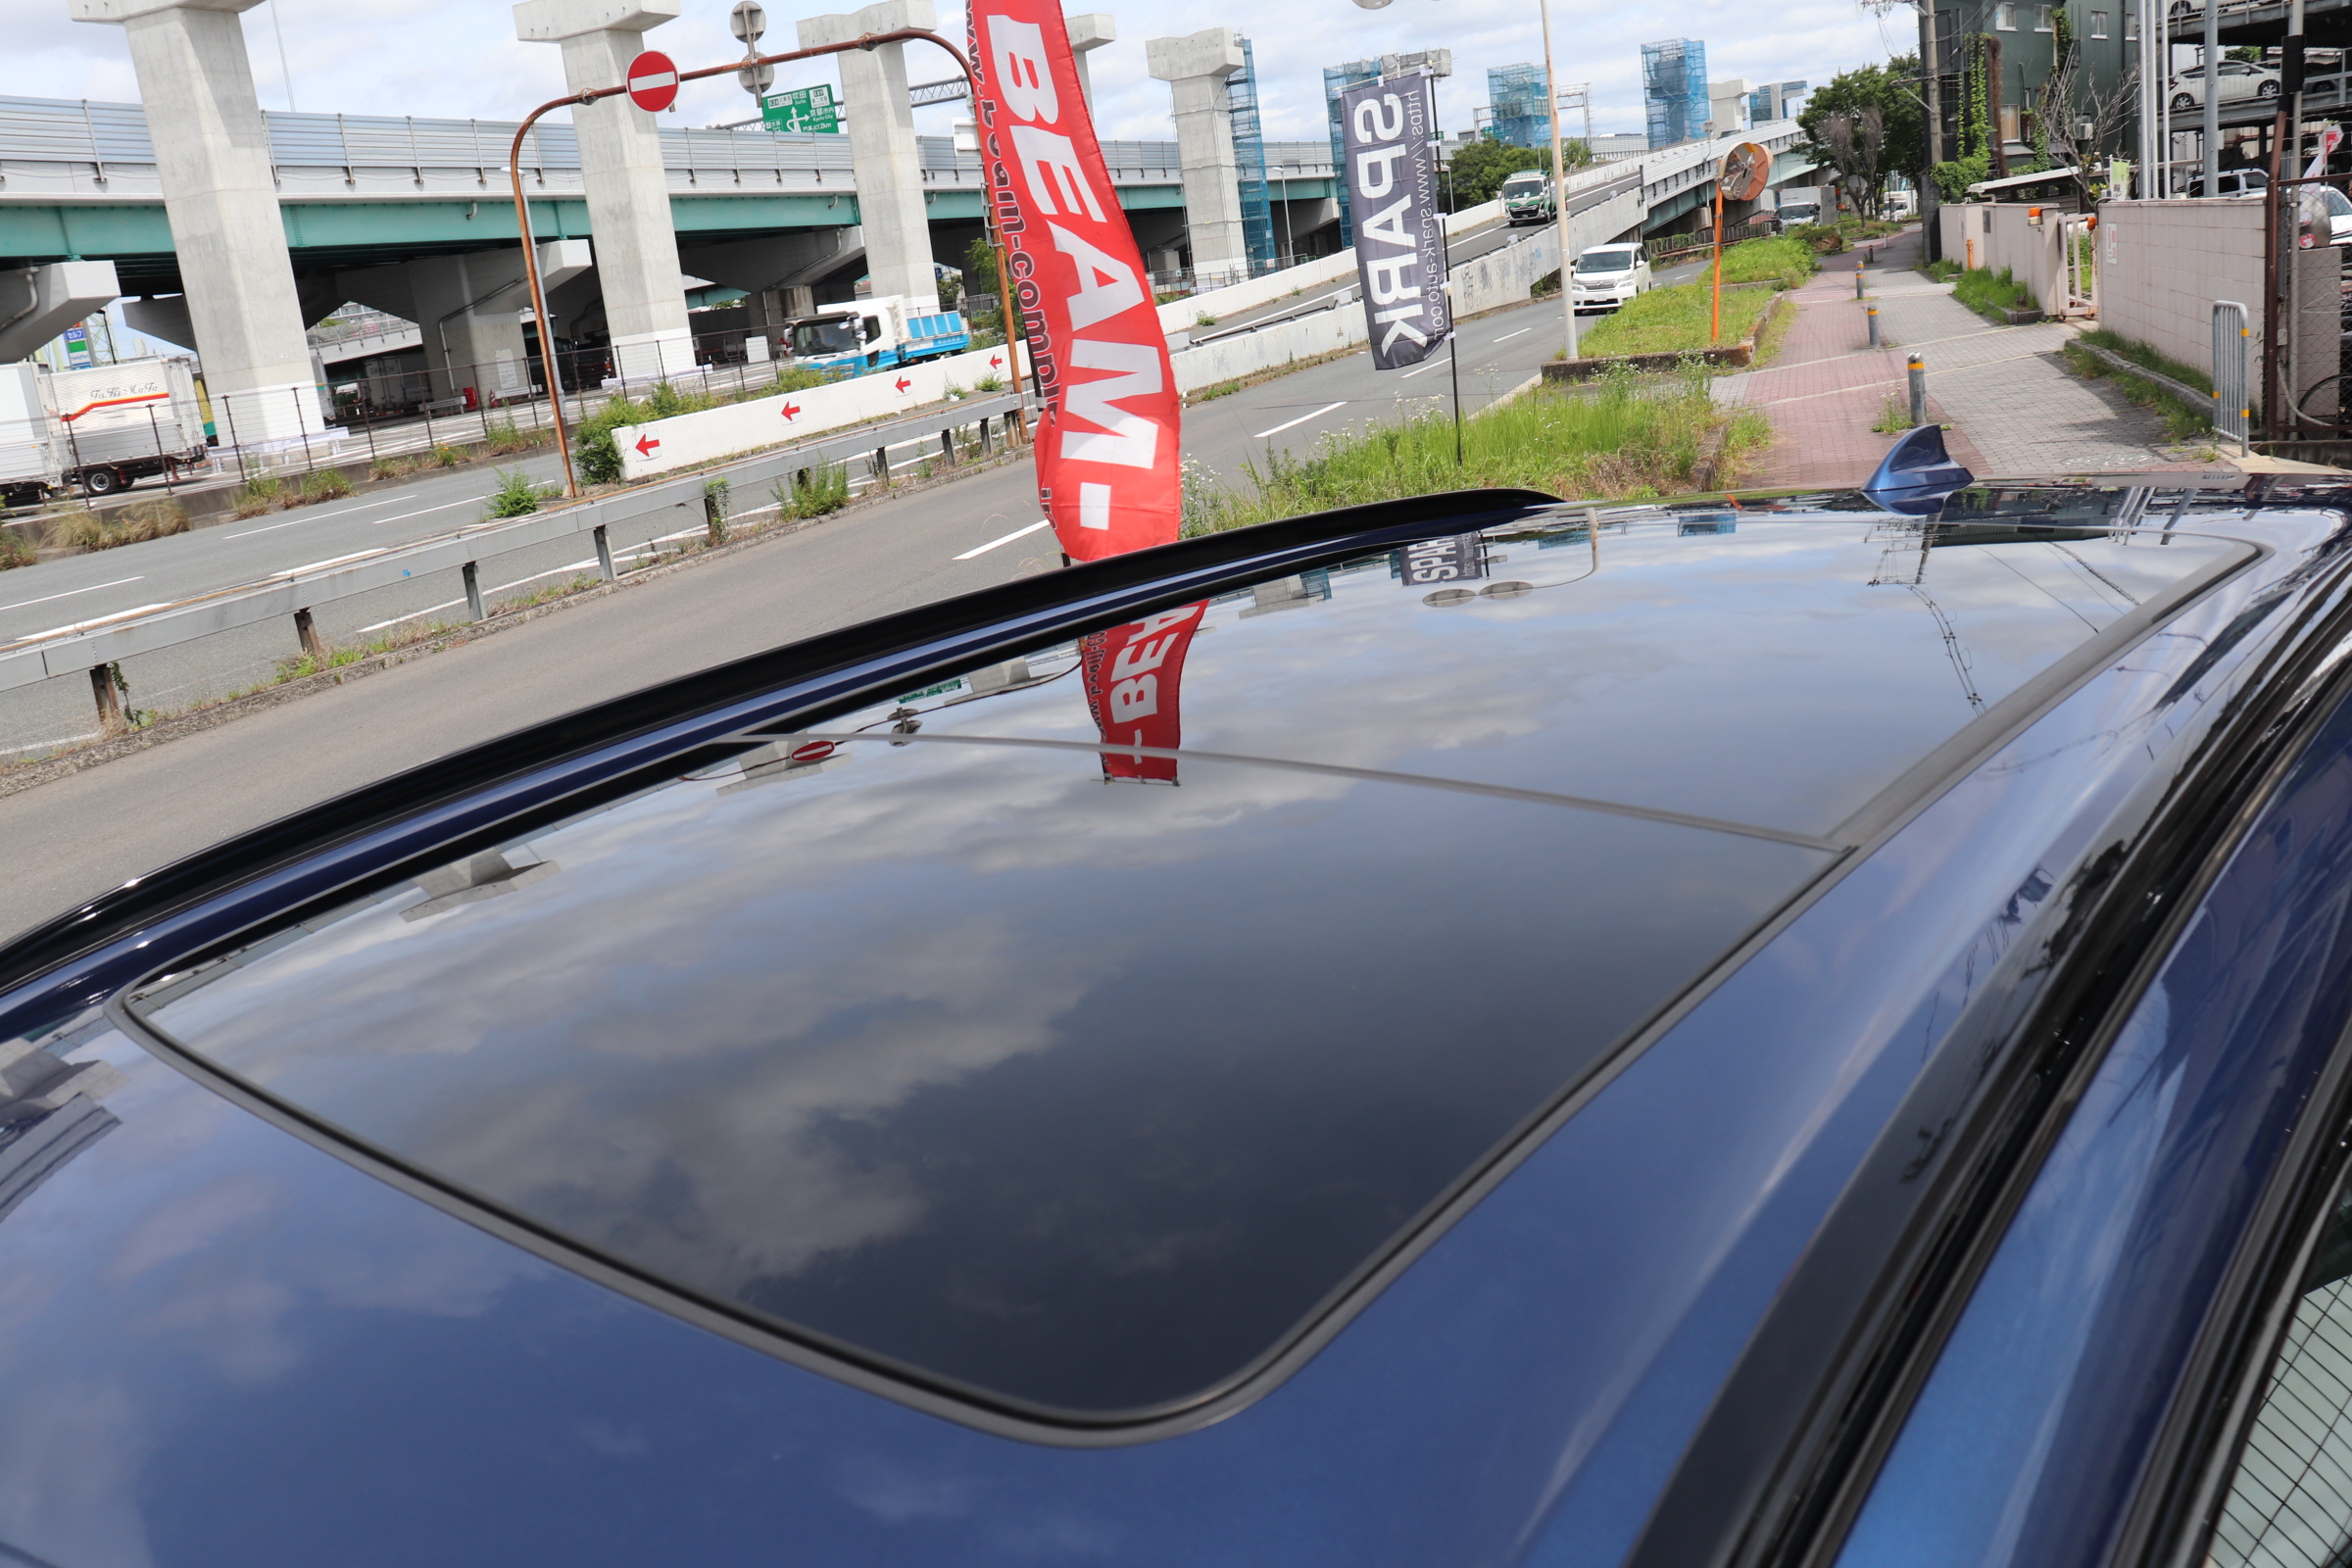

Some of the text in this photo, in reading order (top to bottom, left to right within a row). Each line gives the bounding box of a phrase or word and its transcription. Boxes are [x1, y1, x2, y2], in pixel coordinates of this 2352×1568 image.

[792, 90, 807, 100] 吹田
[67, 329, 82, 339] セルフ
